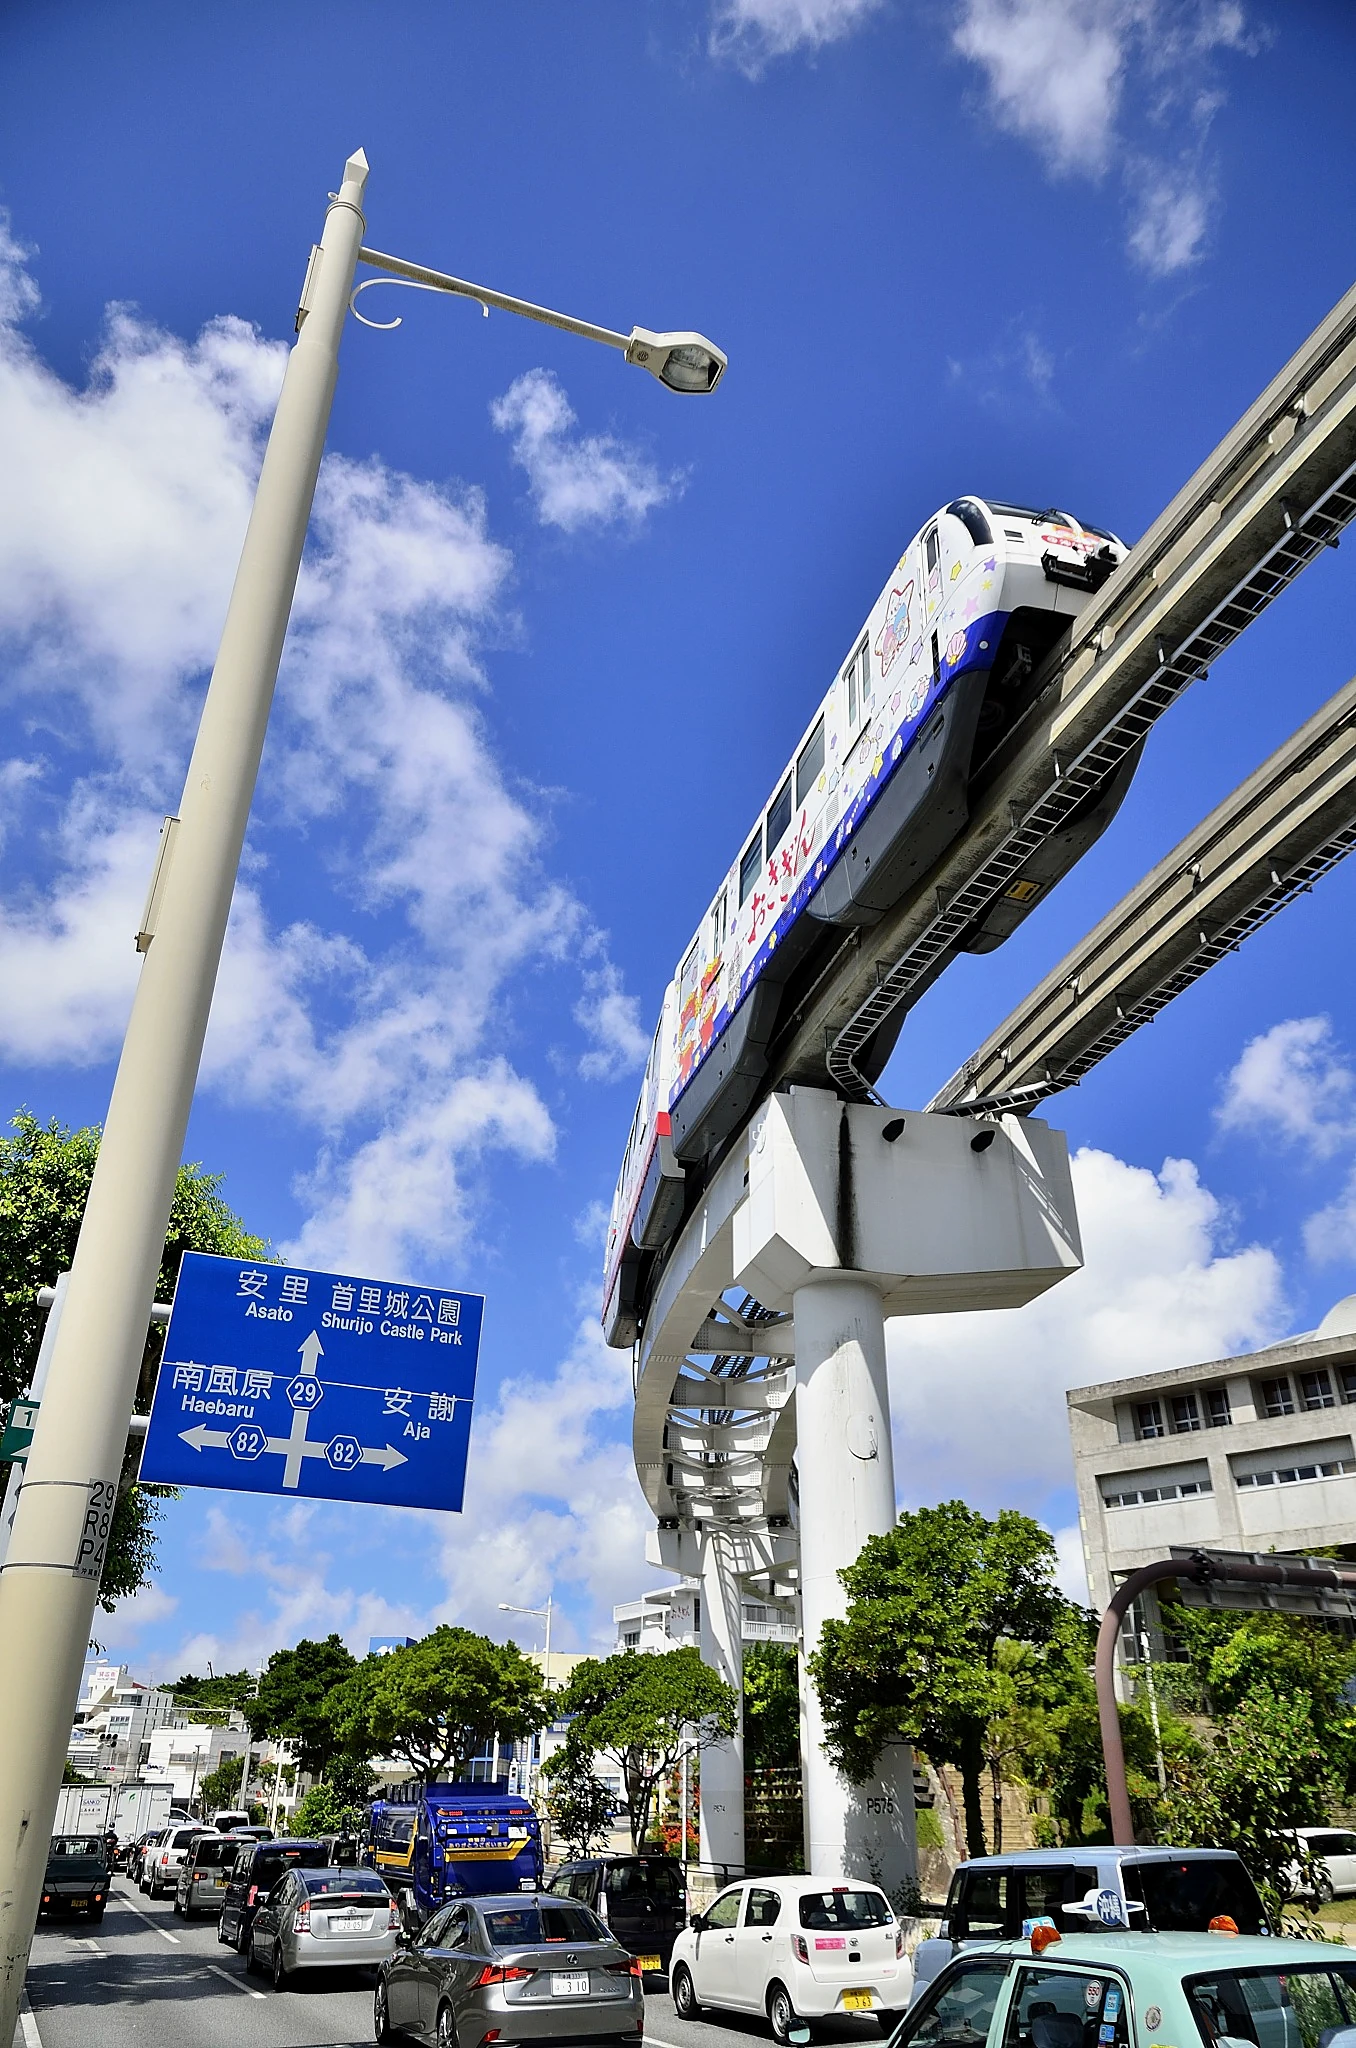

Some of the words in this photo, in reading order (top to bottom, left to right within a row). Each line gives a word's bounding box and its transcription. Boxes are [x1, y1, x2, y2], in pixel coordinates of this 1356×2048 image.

[245, 1301, 294, 1322] Asato
[331, 1281, 461, 1327] 首里城公園
[321, 1312, 374, 1335] Shurijo
[380, 1320, 425, 1341] Castle
[430, 1328, 463, 1346] Park
[171, 1359, 275, 1400] 南風原
[293, 1381, 317, 1402] 29
[181, 1395, 255, 1419] Haebaru
[403, 1421, 431, 1440] Aja
[236, 1432, 259, 1453] 82
[333, 1442, 355, 1464] 82
[89, 1481, 115, 1510] 29
[83, 1510, 110, 1539] R8
[867, 1797, 893, 1814] P575
